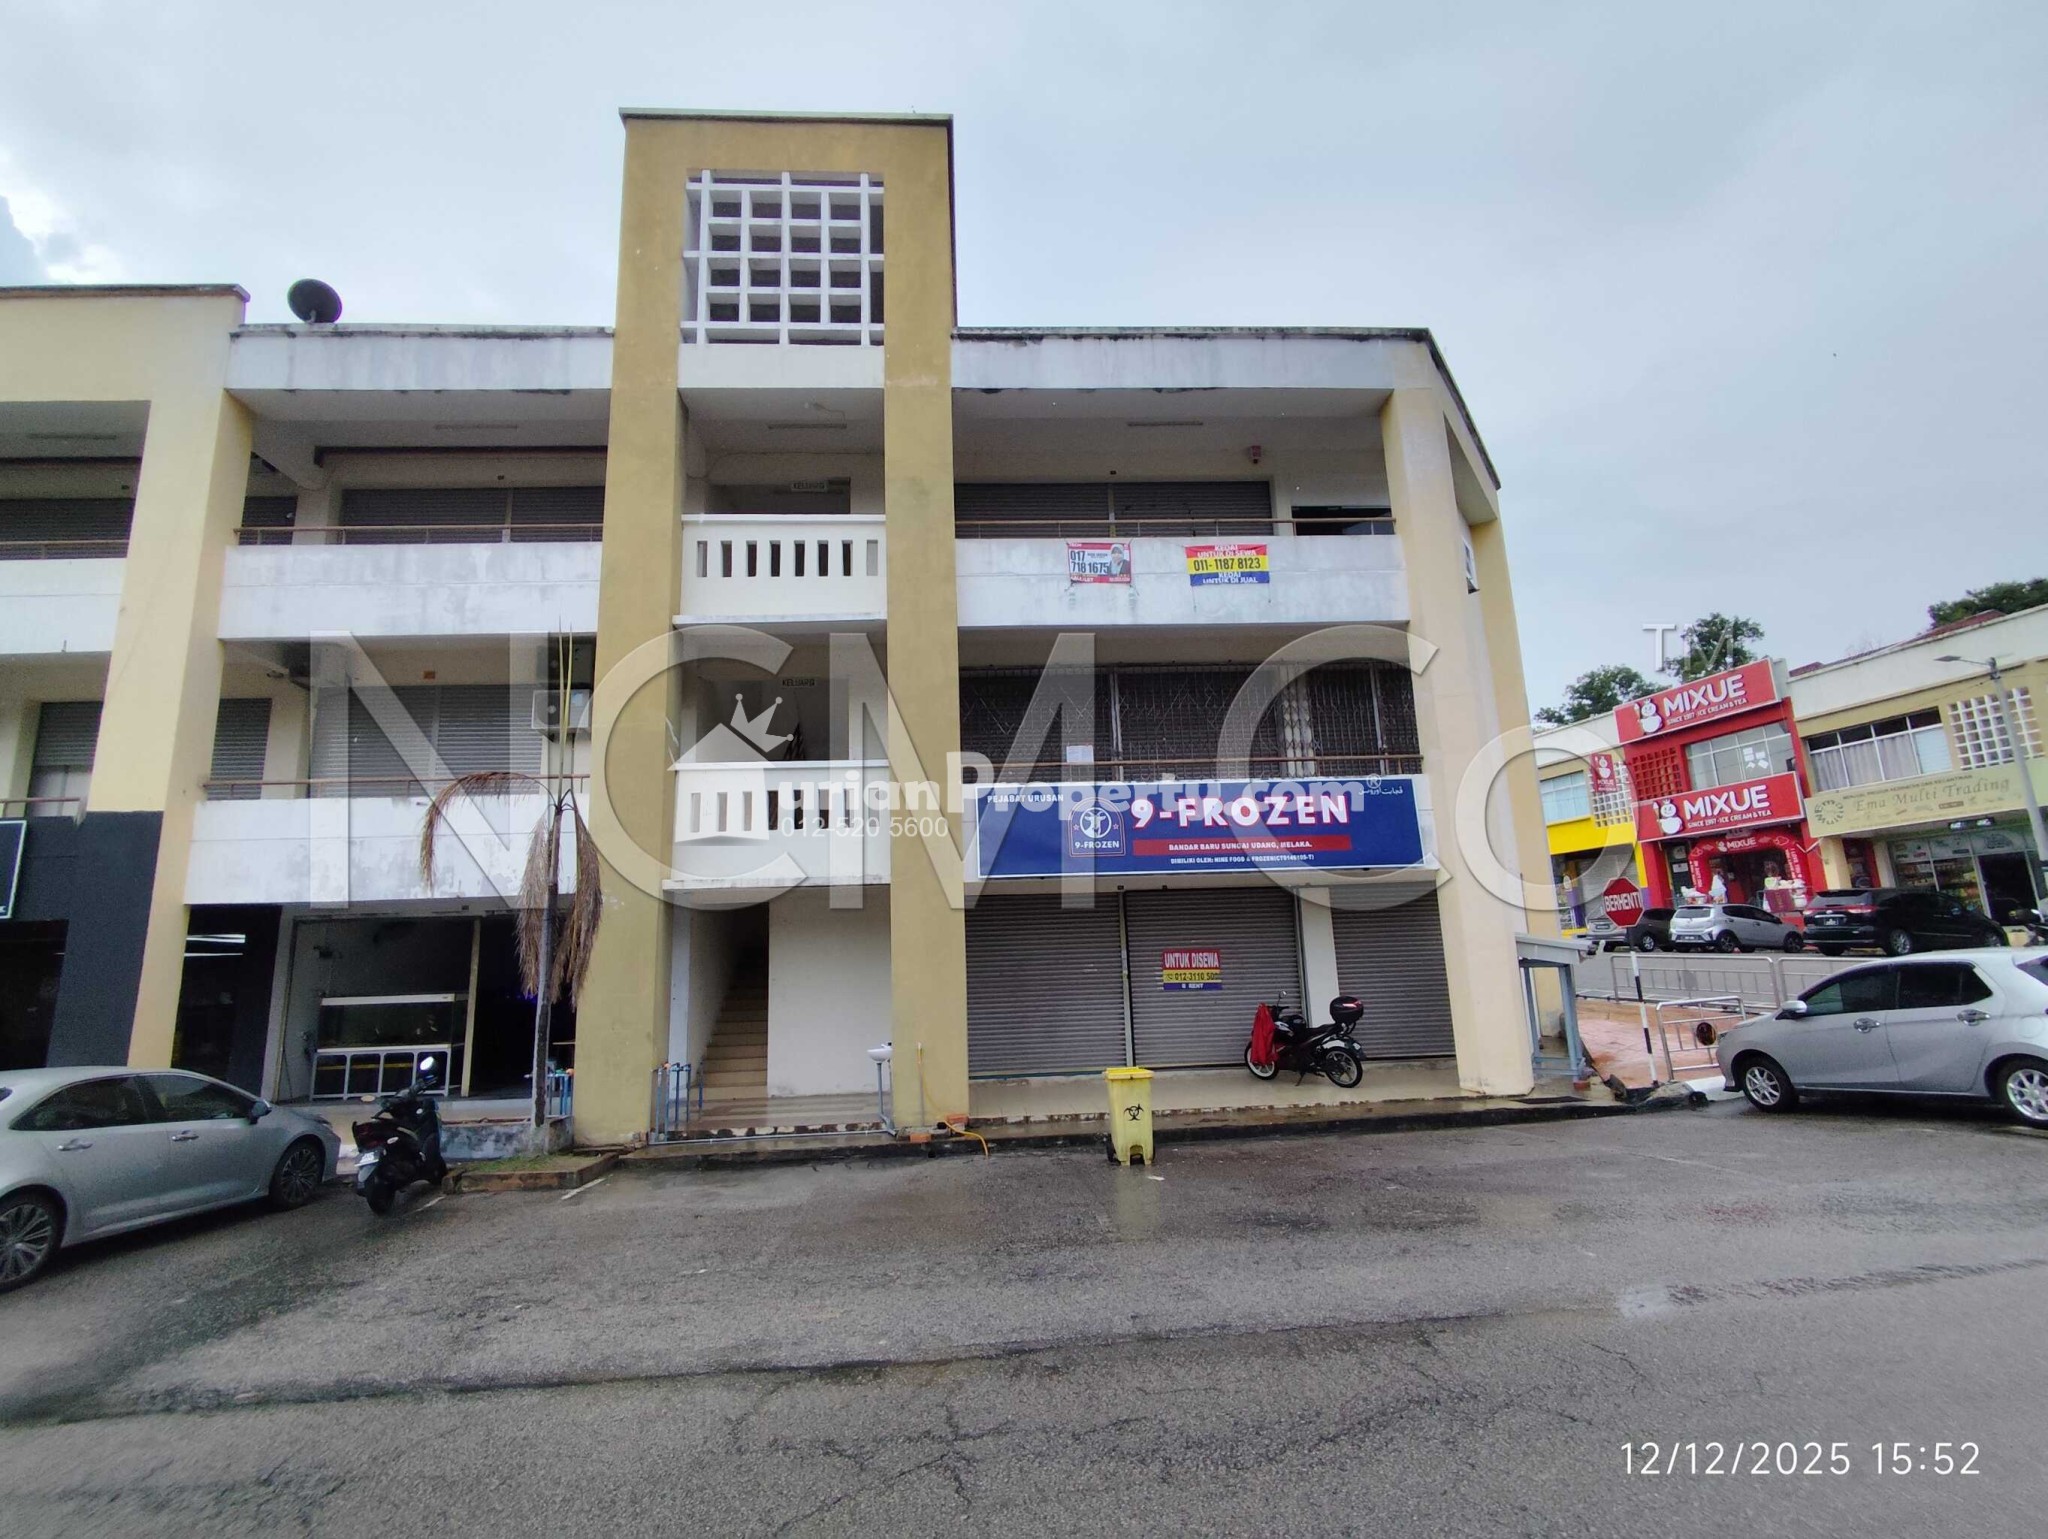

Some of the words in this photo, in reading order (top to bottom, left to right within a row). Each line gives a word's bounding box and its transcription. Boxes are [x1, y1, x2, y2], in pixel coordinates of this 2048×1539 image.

[1070, 550, 1085, 562] 017
[1071, 561, 1086, 574] 718
[1088, 561, 1109, 574] 1675
[1237, 557, 1261, 570] 8123
[1662, 673, 1747, 718] MIXUE
[987, 794, 1026, 804] PEJABAT
[1028, 793, 1064, 803] URUSAN
[1855, 799, 1887, 812] Ema
[1893, 788, 1938, 804] Multi
[1942, 778, 2011, 798] Trading
[1682, 784, 1771, 820] MIXUE
[1131, 794, 1349, 829] 9-FROZEN
[1074, 840, 1120, 850] 9-FROZEN
[1168, 843, 1199, 851] BANDAR
[1199, 842, 1220, 850] BARU
[1221, 841, 1249, 850] SUNGAI
[1250, 841, 1279, 850] UDANG,
[1726, 836, 1757, 849] MIXUE
[1604, 891, 1641, 912] BERHENTI
[1164, 952, 1191, 968] UNTUK
[1191, 952, 1220, 968] DISEWA
